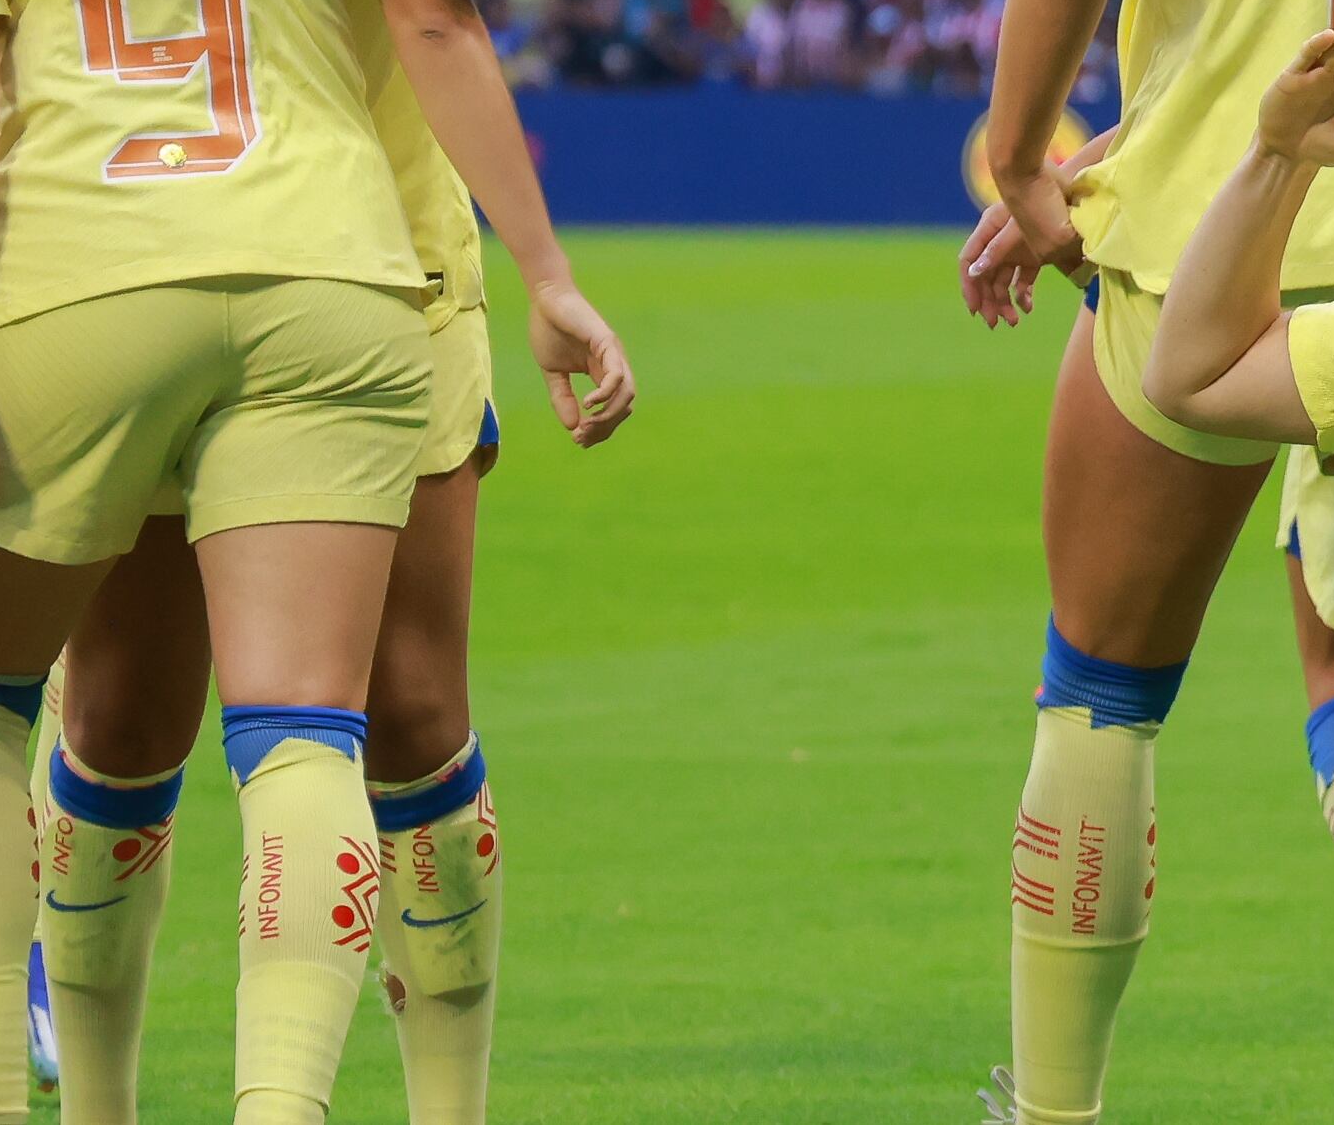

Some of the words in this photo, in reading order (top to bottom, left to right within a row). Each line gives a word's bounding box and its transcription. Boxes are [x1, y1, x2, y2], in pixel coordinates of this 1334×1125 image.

[257, 833, 284, 940] INFONAVIT
[412, 823, 439, 893] INFON
[1071, 819, 1106, 935] INFONAVIT
